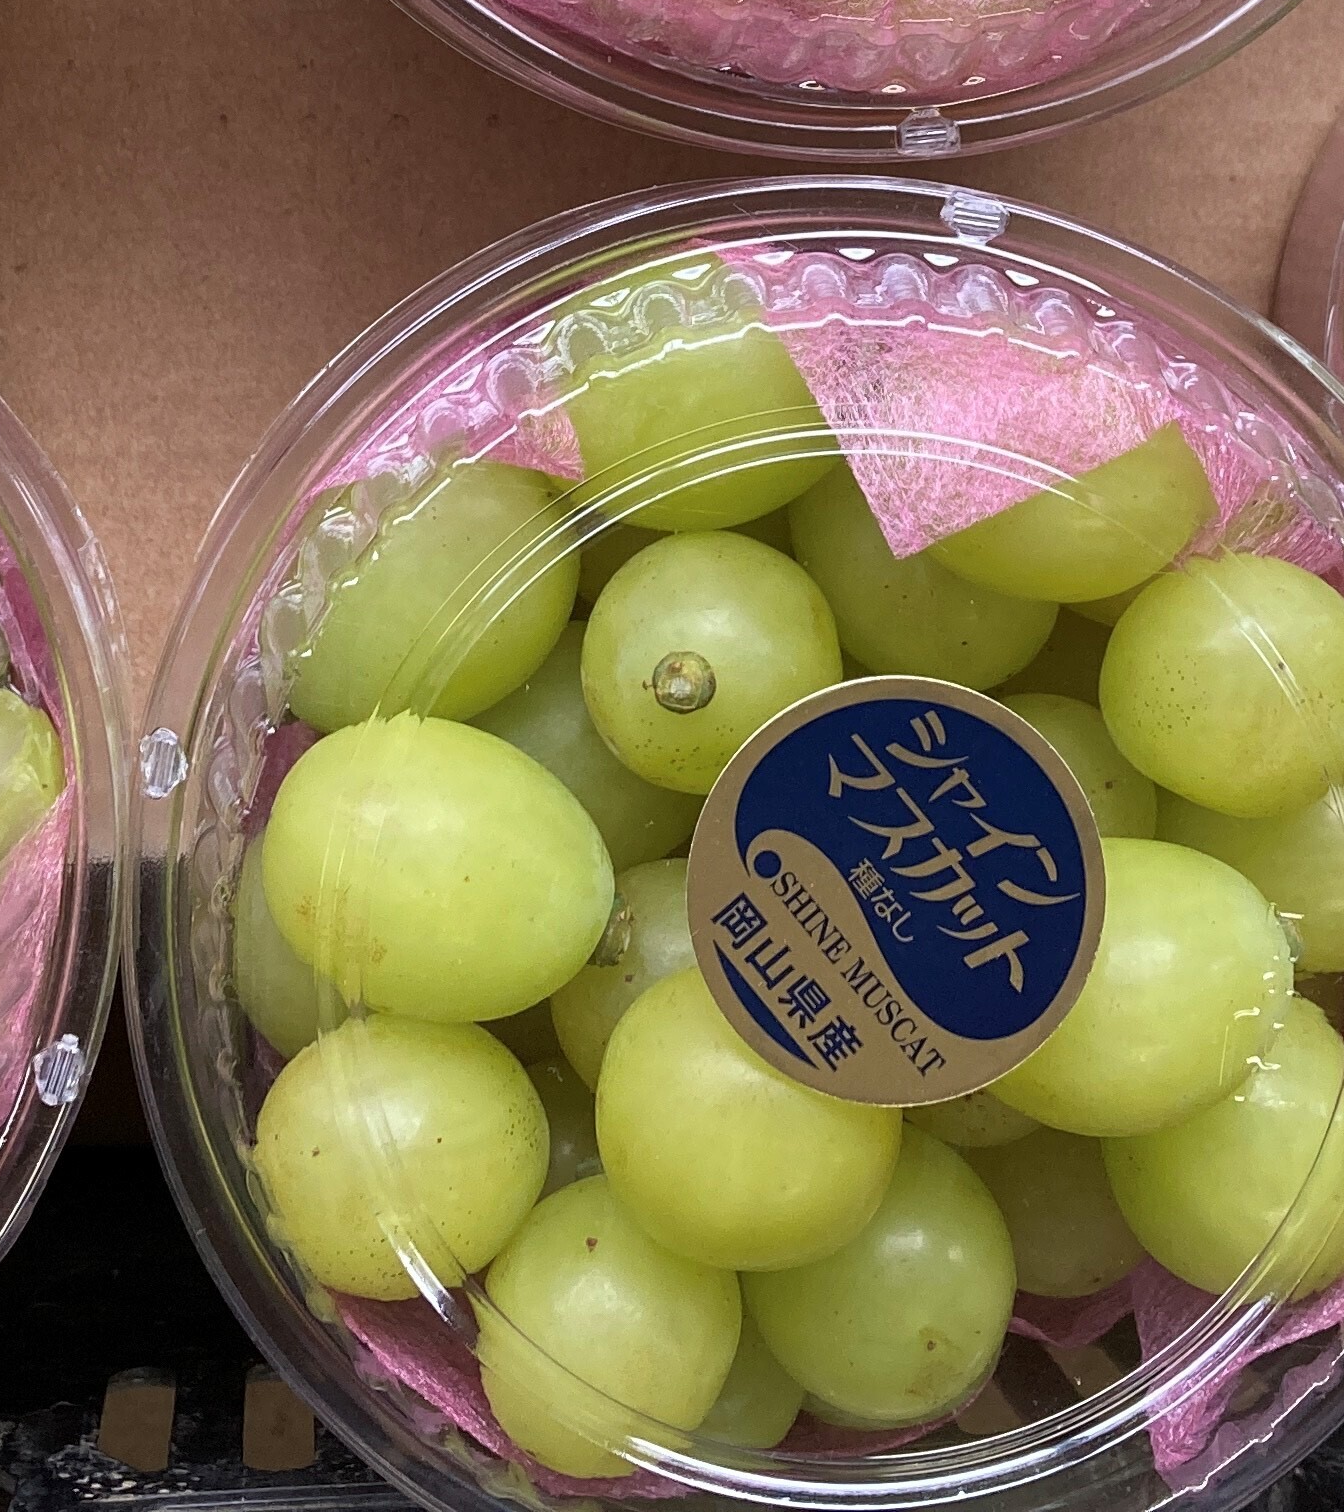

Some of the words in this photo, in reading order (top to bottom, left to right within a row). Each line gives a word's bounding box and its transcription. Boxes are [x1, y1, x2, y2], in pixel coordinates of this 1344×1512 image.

[828, 733, 1031, 994] マスカット
[847, 857, 914, 944] 種なし
[886, 710, 1081, 905] シャイン
[710, 892, 864, 1073] 岡山県産
[769, 871, 852, 966] SHINE
[840, 955, 947, 1078] MUSCAT
